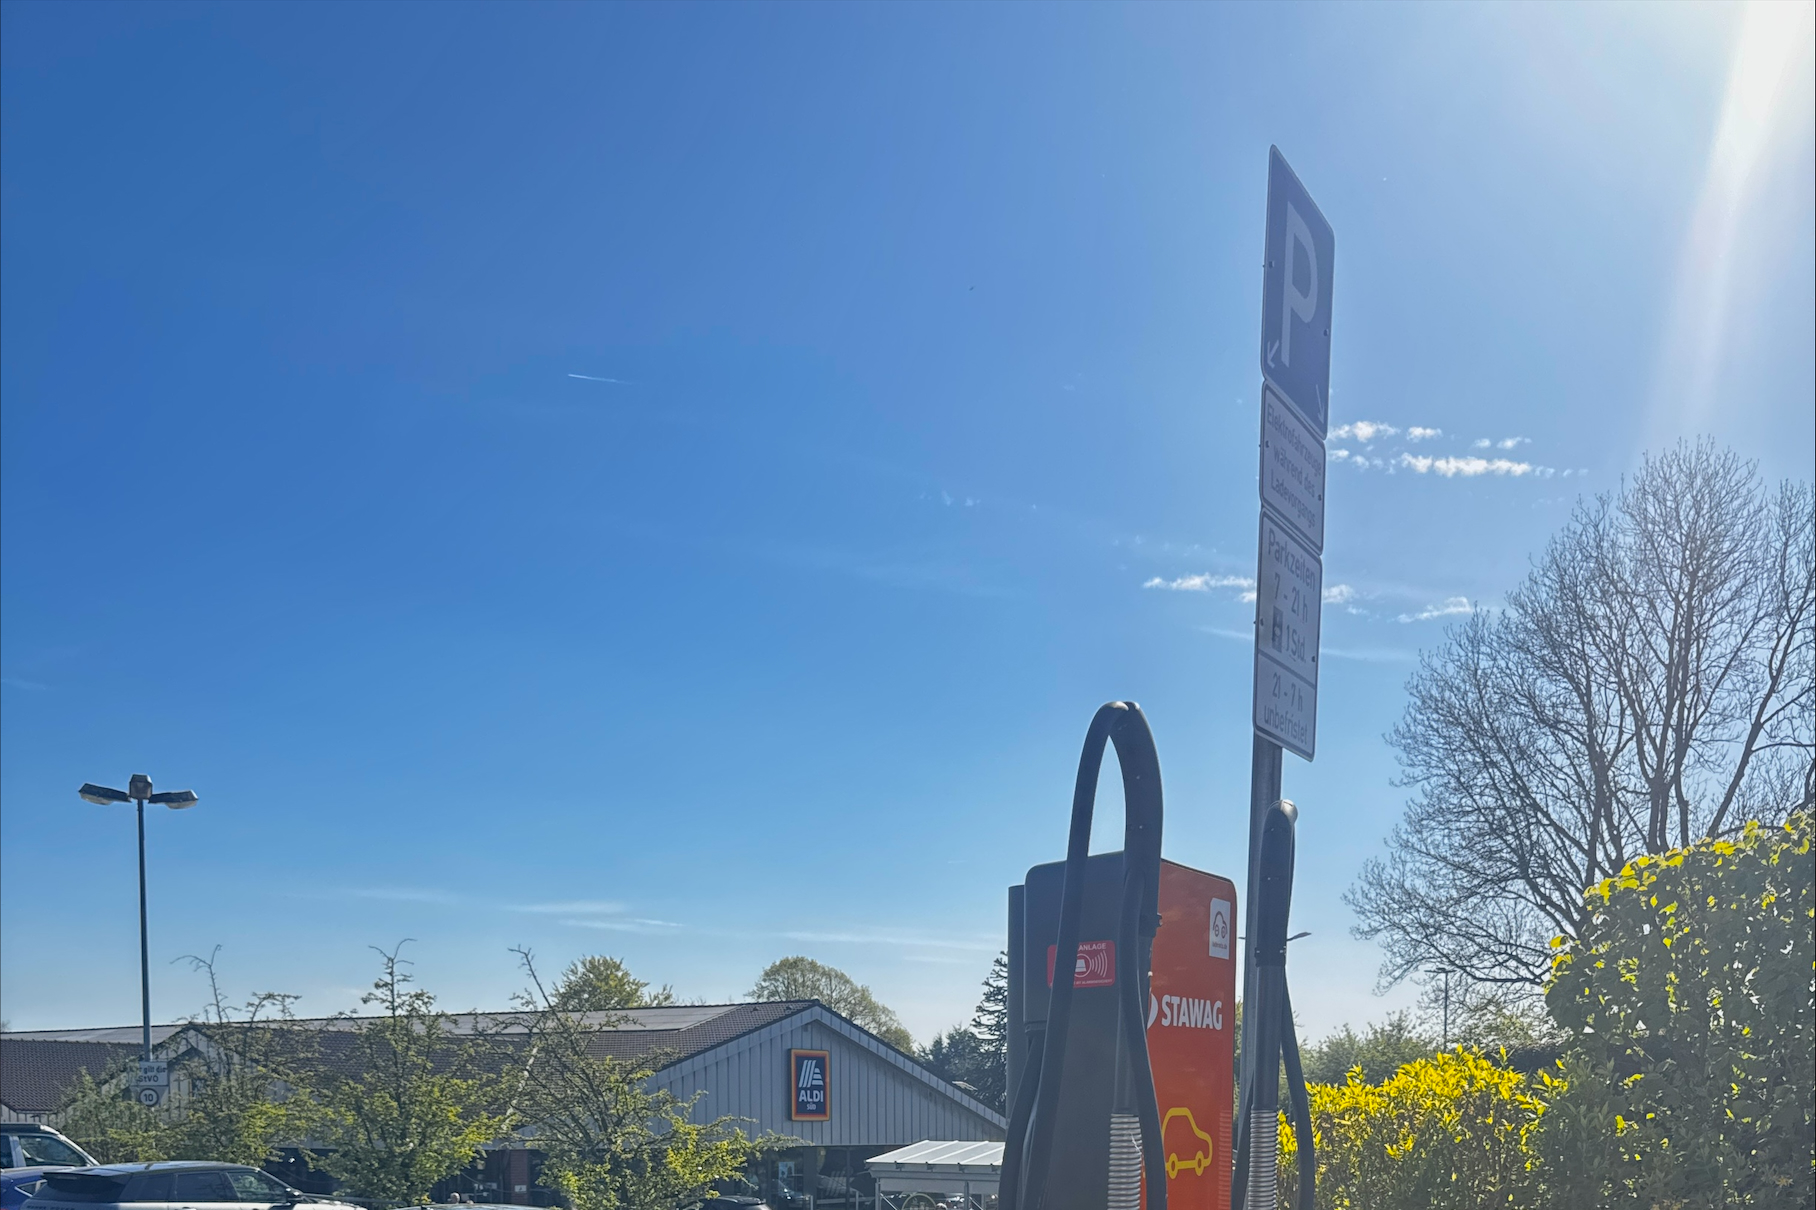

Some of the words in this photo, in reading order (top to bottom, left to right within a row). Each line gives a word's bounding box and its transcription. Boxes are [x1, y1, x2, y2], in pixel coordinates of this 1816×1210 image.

[1281, 201, 1318, 368] P
[1266, 403, 1322, 478] Elektrofahrzeuge
[1273, 445, 1302, 485] während
[1303, 469, 1316, 499] des
[1270, 468, 1316, 529] Ladevorgangs
[1267, 527, 1316, 593] Parkzeiten
[1274, 572, 1281, 600] 7
[1291, 587, 1300, 617] 21
[1302, 594, 1308, 624] h
[1272, 672, 1281, 700] 21
[1290, 681, 1296, 708] 7
[1297, 686, 1303, 713] h
[1263, 704, 1308, 746] unbefristet
[1161, 994, 1223, 1031] STAWAG
[138, 1075, 159, 1083] StVO
[143, 1093, 154, 1102] 10
[799, 1090, 824, 1102] ALDI
[806, 1102, 817, 1111] SÜD
